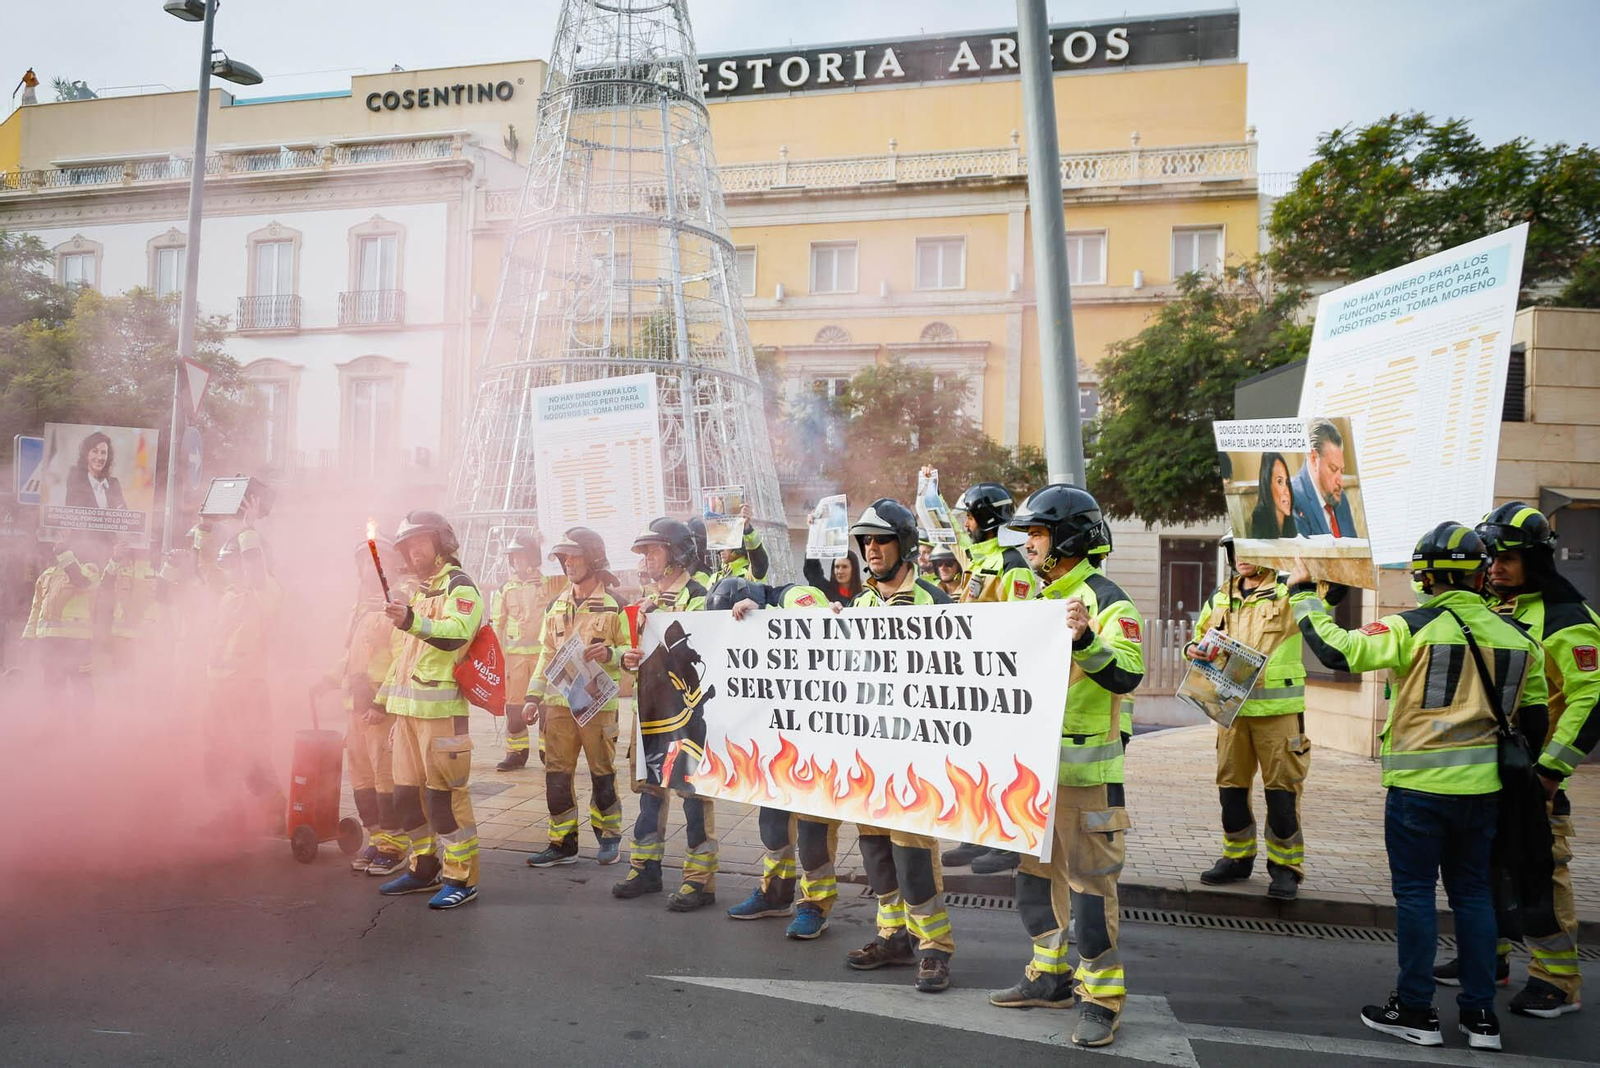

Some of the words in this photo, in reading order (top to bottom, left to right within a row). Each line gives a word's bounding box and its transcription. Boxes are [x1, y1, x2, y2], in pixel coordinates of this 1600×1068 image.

[948, 27, 1130, 72] AROS
[366, 81, 514, 112] COSENTINO
[1338, 290, 1418, 322] FUNCIONARIOS
[1421, 278, 1453, 296] PERO
[1457, 266, 1491, 283] PARA
[1343, 298, 1358, 309] NO
[1360, 289, 1381, 304] HAY
[1383, 275, 1426, 296] DINERO
[1428, 263, 1460, 281] PARA
[1463, 253, 1489, 269] LOS
[1329, 311, 1387, 337] NOSOTROS
[1406, 296, 1439, 312] TOMA
[1441, 276, 1497, 301] MORENO
[548, 400, 598, 412] FUNCIONARIOS
[600, 396, 620, 405] PERO
[620, 394, 640, 402] PARA
[575, 390, 601, 400] DINERO
[602, 388, 622, 396] PARA
[622, 386, 638, 394] LOS
[544, 410, 581, 420] NOSOTROS
[592, 406, 612, 414] TOMA
[614, 402, 644, 412] MORENO
[1236, 438, 1246, 448] DEL
[1248, 438, 1260, 448] MAR
[1284, 438, 1306, 448] LORCA
[1266, 424, 1280, 434] DIGO
[768, 618, 812, 640] SIN
[822, 610, 973, 640] INVERSIÓN
[727, 648, 759, 669] NO
[767, 648, 799, 670] SE
[807, 649, 898, 673] PUEDE
[907, 650, 964, 675] DAR
[973, 651, 1017, 677] UN
[727, 677, 848, 703] SERVICIO
[855, 682, 894, 706] DE
[903, 684, 1033, 715] CALIDAD
[769, 708, 801, 731] AL
[808, 711, 972, 746] CIUDADANO
